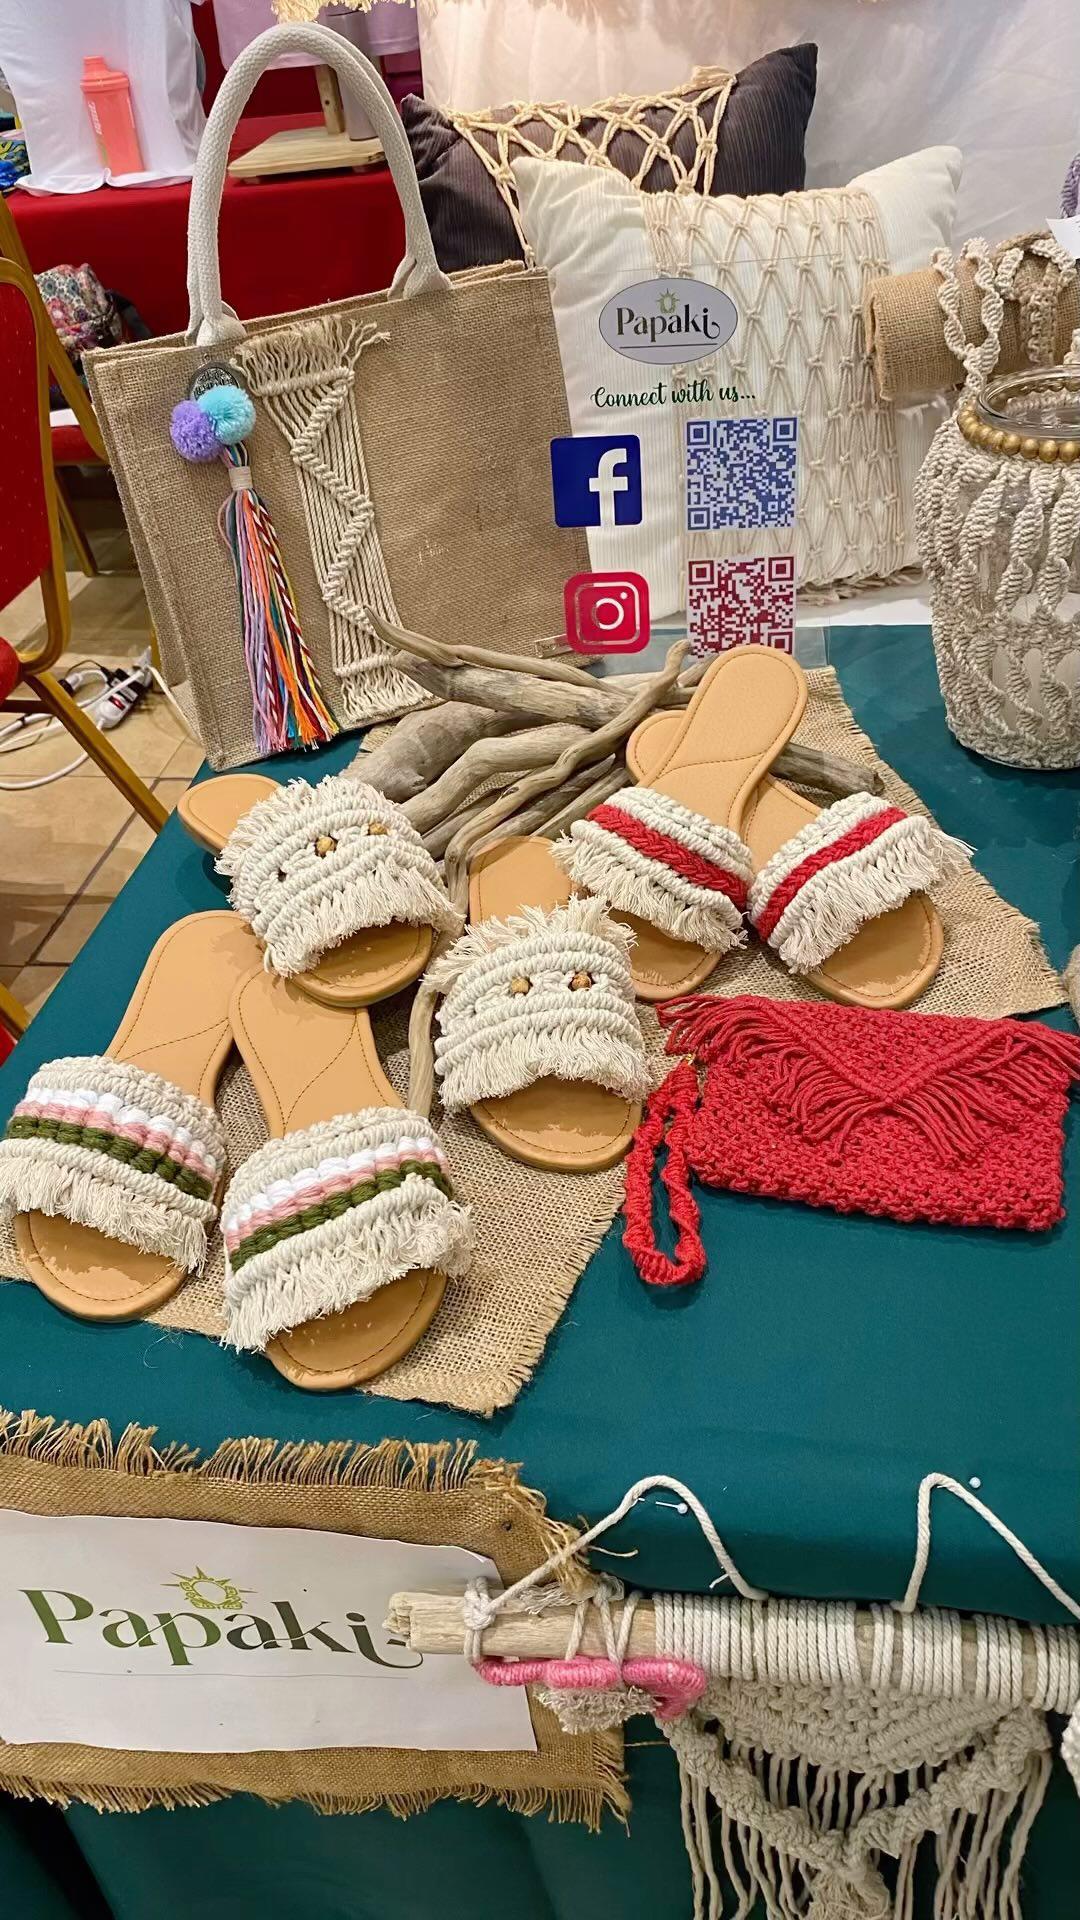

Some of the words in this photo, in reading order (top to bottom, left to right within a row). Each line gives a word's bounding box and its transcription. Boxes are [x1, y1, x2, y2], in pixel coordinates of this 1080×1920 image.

[616, 303, 721, 343] Papaki
[589, 382, 667, 408] Connect
[671, 379, 714, 403] with
[719, 385, 756, 402] us...
[18, 1588, 424, 1669] Papaki
